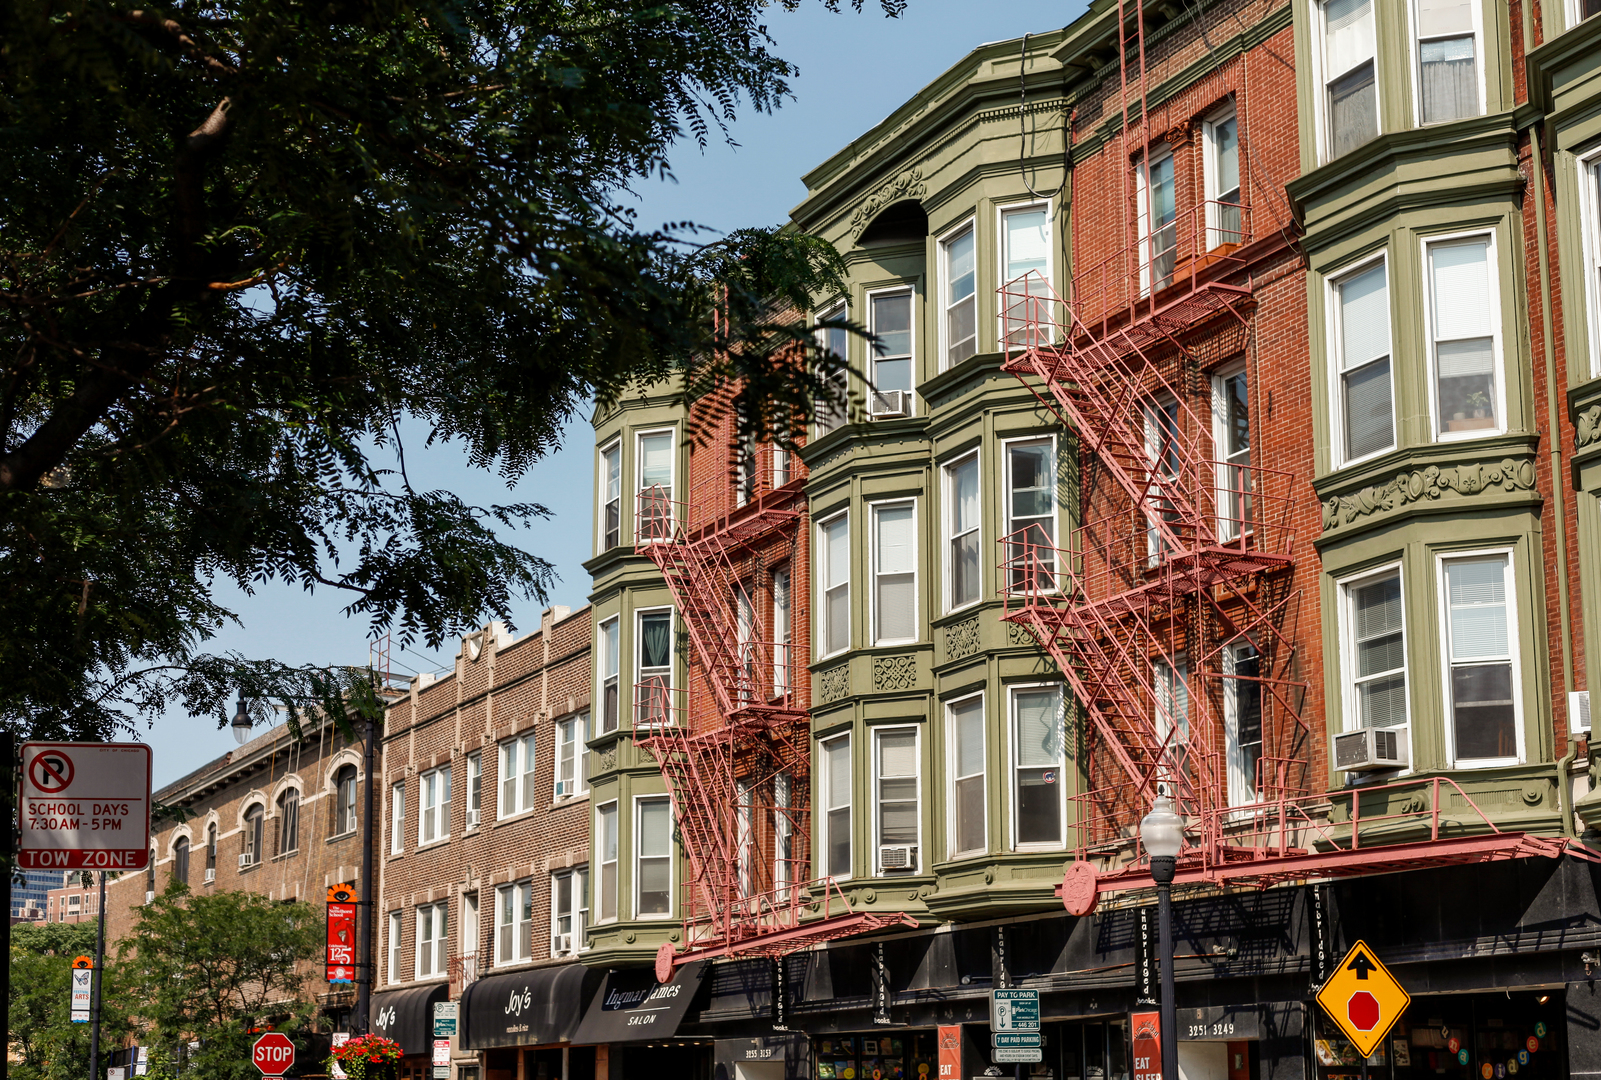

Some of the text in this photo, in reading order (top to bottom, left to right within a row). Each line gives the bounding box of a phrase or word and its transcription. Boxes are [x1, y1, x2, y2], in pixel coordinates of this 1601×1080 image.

[28, 803, 129, 816] SCHOOL DAYS
[26, 850, 136, 866] TOW ZONE
[330, 947, 352, 964] 125
[1141, 908, 1149, 994] unabridged
[504, 986, 532, 1017] Joy's
[605, 982, 681, 1010] Ingmar James
[375, 1006, 396, 1030] Joy's
[628, 1014, 656, 1026] SALON
[1189, 1023, 1234, 1036] 3251 3249
[256, 1046, 292, 1062] STOP
[940, 1064, 952, 1075] EAT
[1135, 1057, 1150, 1070] EAT
